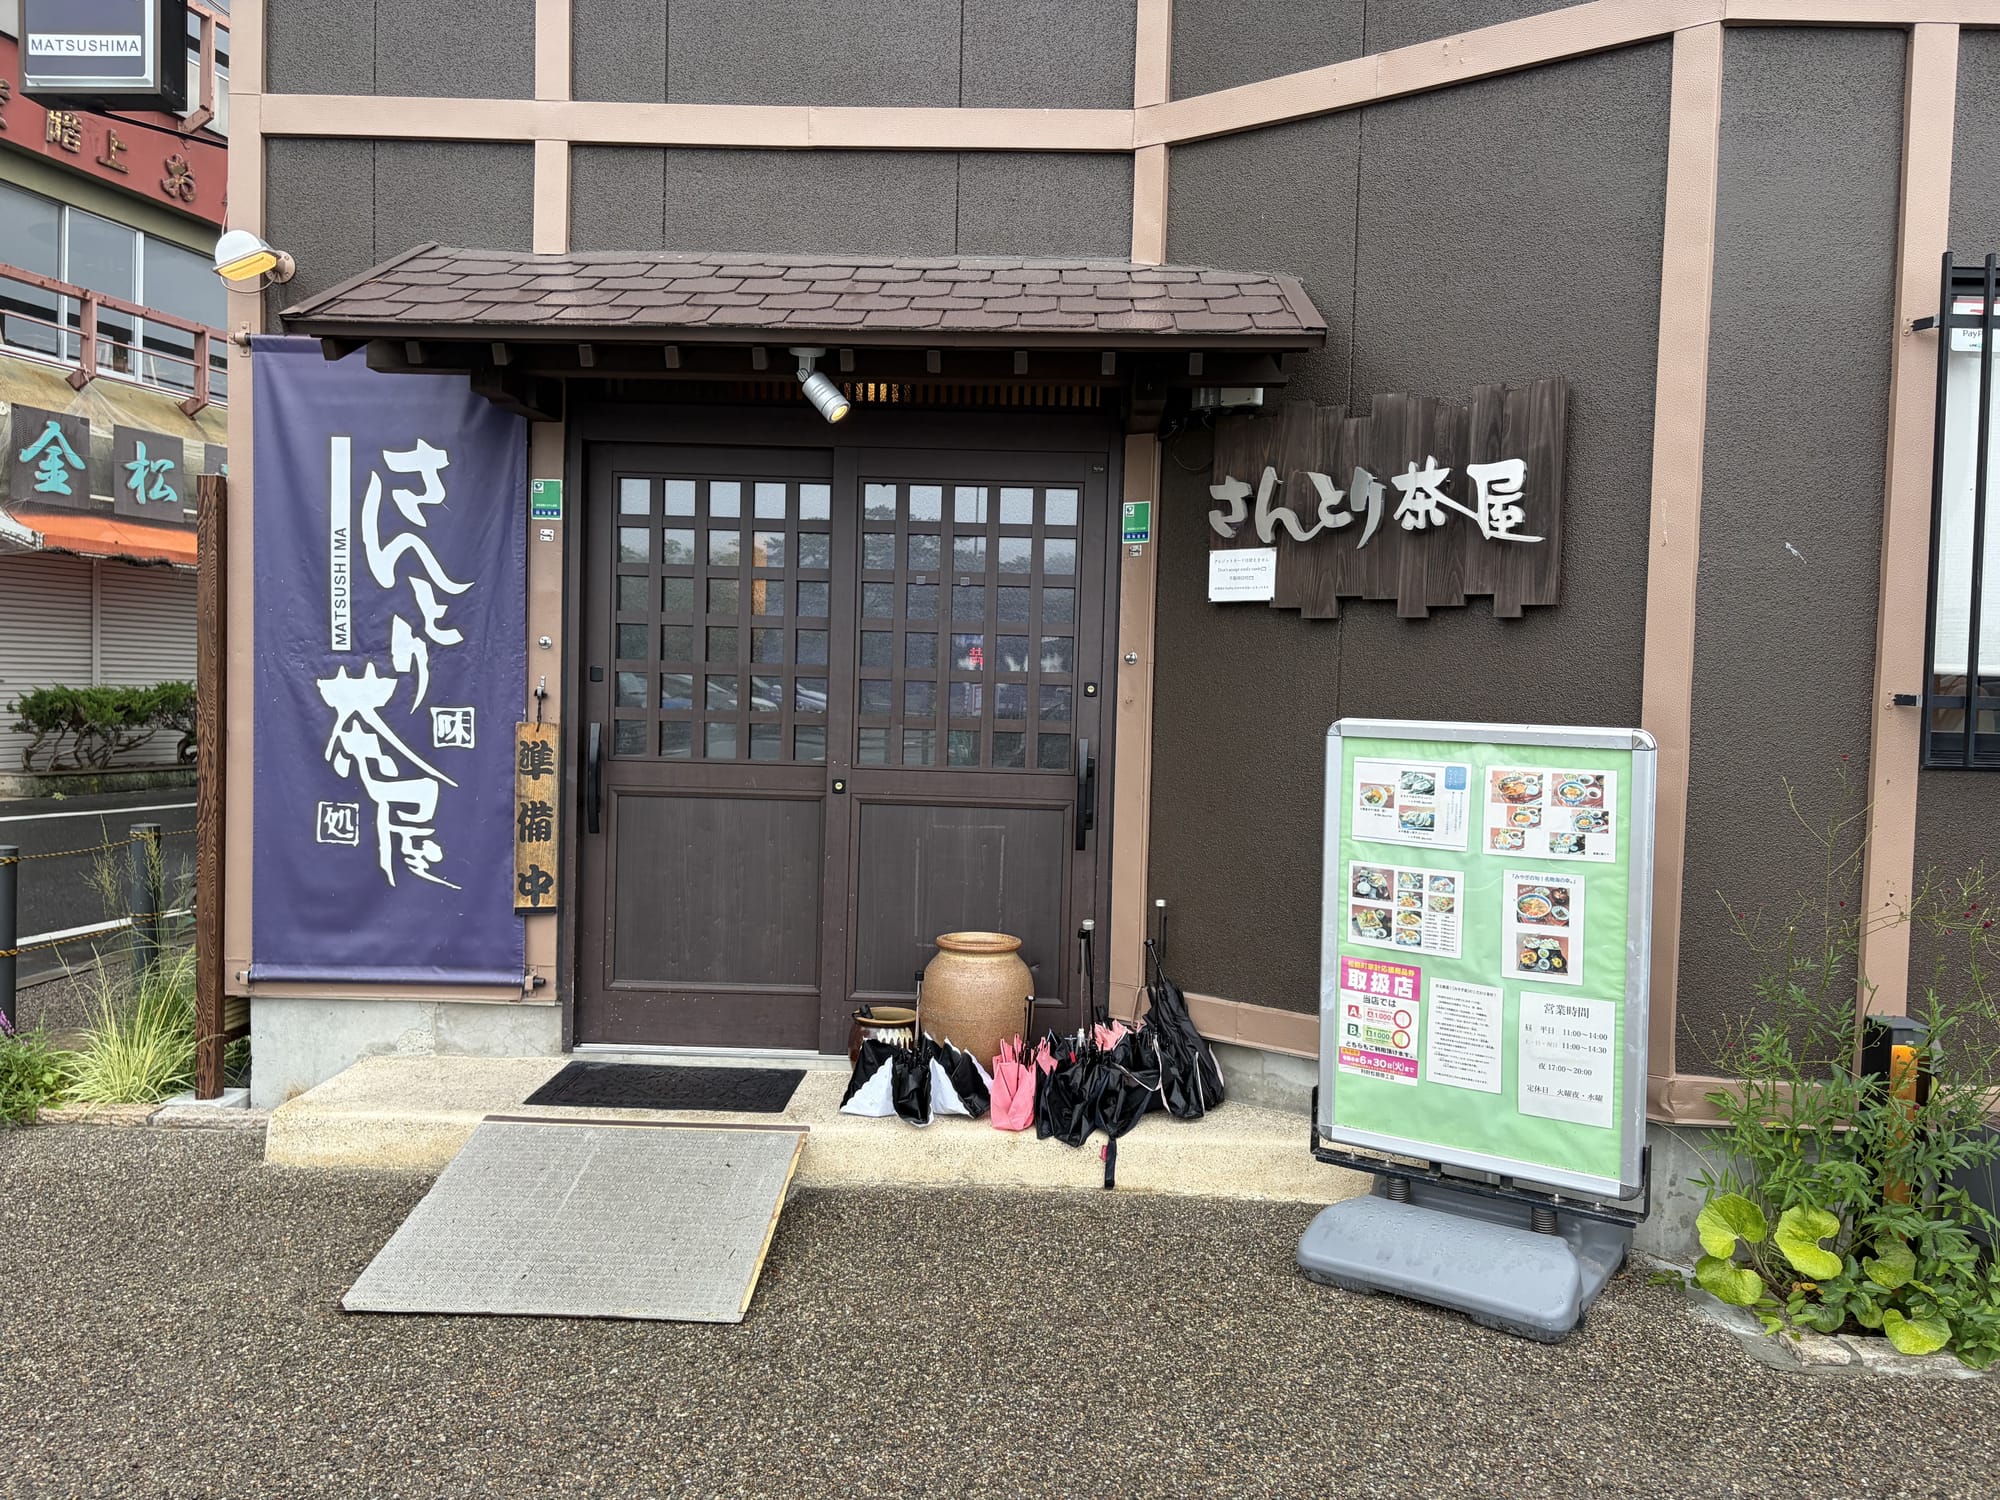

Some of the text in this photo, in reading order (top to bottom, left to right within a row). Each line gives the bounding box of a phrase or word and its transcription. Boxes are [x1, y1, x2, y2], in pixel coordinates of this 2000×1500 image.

[31, 39, 139, 53] MATSUSHIMA
[19, 420, 227, 505] 金松
[1208, 455, 1546, 550] さんとり茶屋
[335, 527, 348, 646] MATSUSHIMA
[436, 709, 473, 744] 味
[322, 805, 357, 841] 処
[518, 739, 554, 906] 準備中
[1347, 968, 1414, 999] 取扱店
[1363, 994, 1397, 1008] 当店では
[1544, 1003, 1590, 1019] 営業時間
[1541, 1025, 1555, 1034] 平日
[1538, 1062, 1546, 1070] 夜
[1527, 1084, 1549, 1093] 定休日
